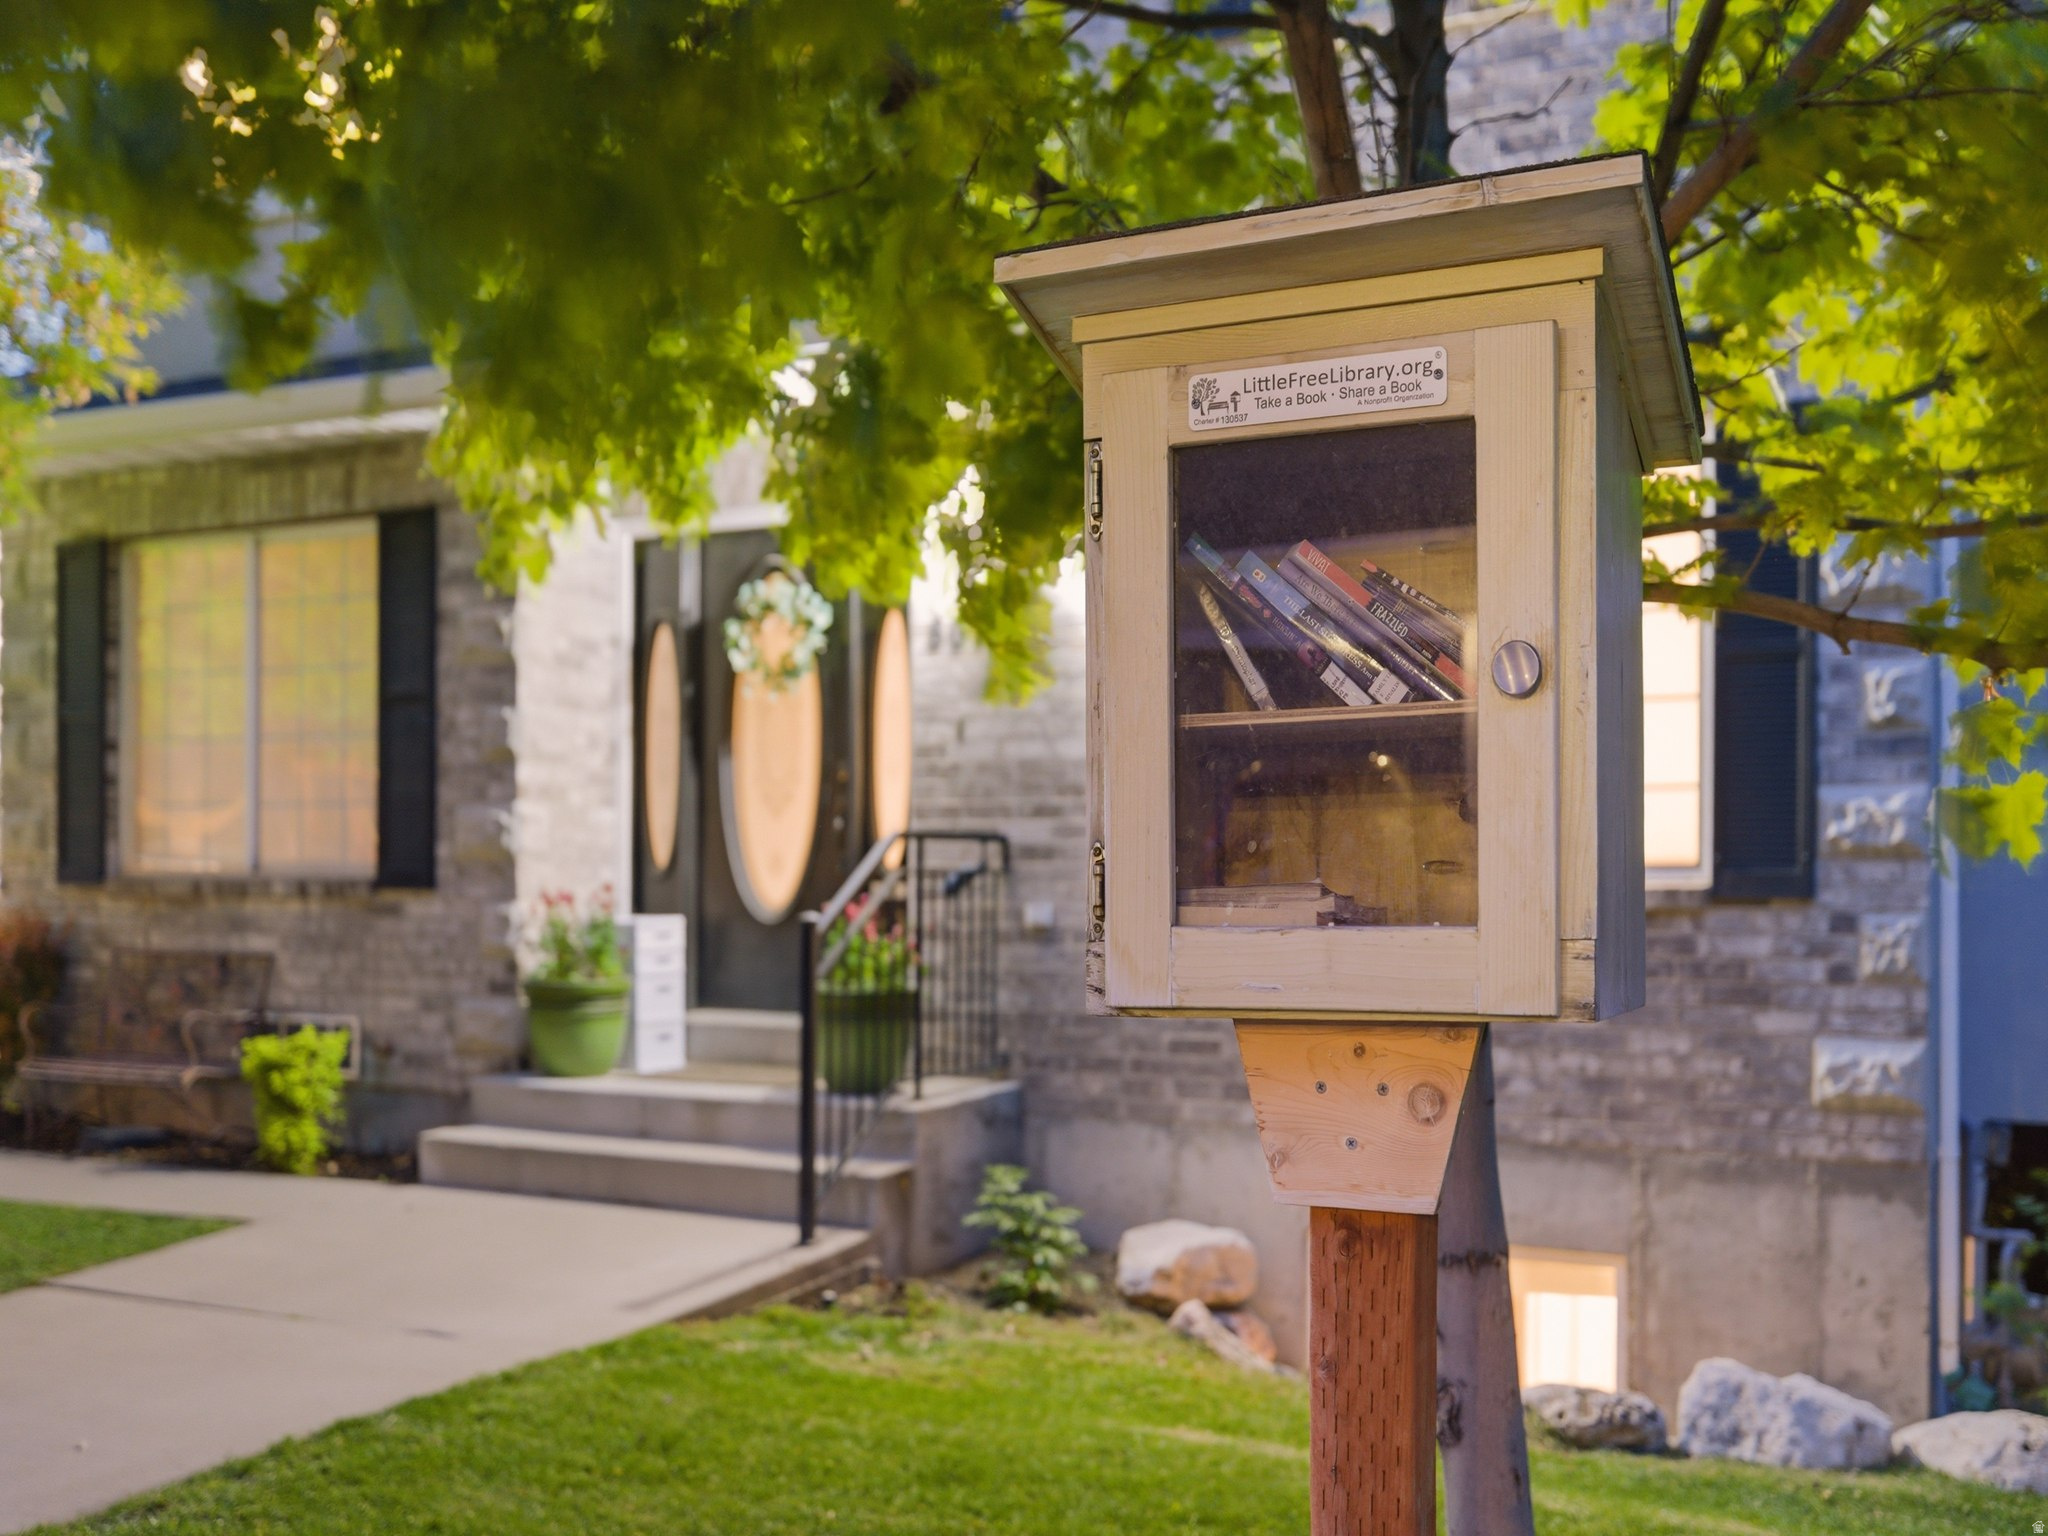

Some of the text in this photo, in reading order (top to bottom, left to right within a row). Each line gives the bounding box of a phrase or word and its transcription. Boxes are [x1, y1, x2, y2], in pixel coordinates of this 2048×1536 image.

[1243, 360, 1433, 394] LittleFreeLibrary.org
[1254, 379, 1422, 410] Take a Book Share a Book
[1364, 397, 1392, 405] Nonprofit
[1393, 392, 1434, 403] Organization
[1193, 417, 1215, 426] Charter
[1300, 610, 1321, 629] LAST
